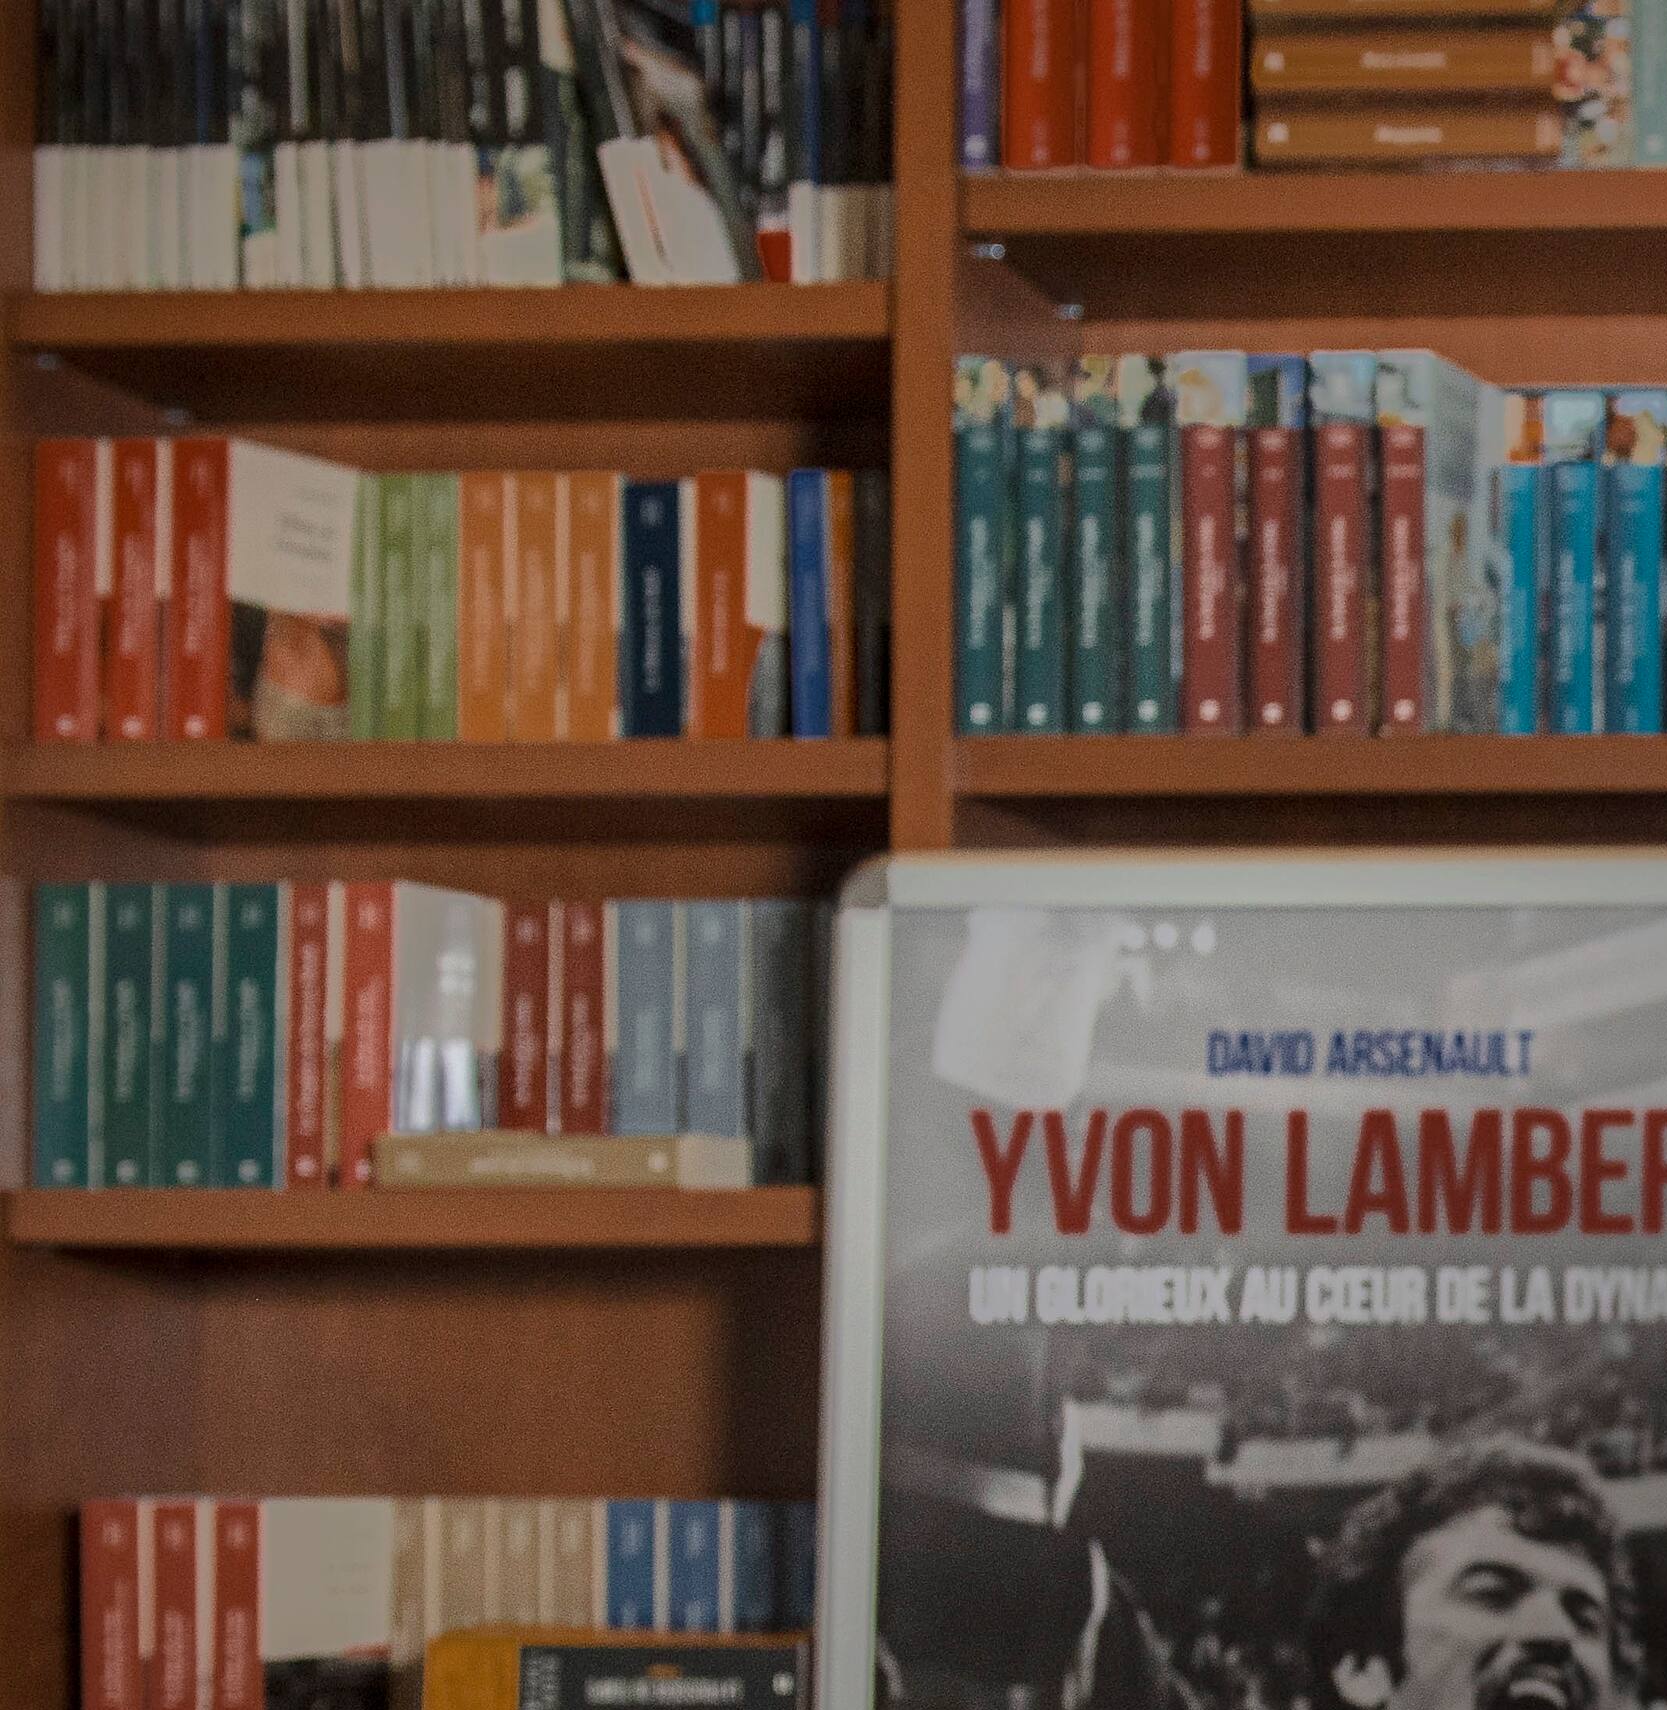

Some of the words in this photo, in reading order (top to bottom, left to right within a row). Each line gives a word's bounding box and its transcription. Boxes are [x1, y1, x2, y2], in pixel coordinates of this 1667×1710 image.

[1207, 1031, 1315, 1077] DAVID
[1326, 1031, 1533, 1077] ARSENAULT
[969, 1108, 1243, 1236] YVON
[969, 1265, 1029, 1325] UN
[1035, 1265, 1232, 1325] GLORIEUX
[1240, 1265, 1299, 1325] AU
[1436, 1265, 1491, 1325] DE
[1501, 1265, 1555, 1325] LA
